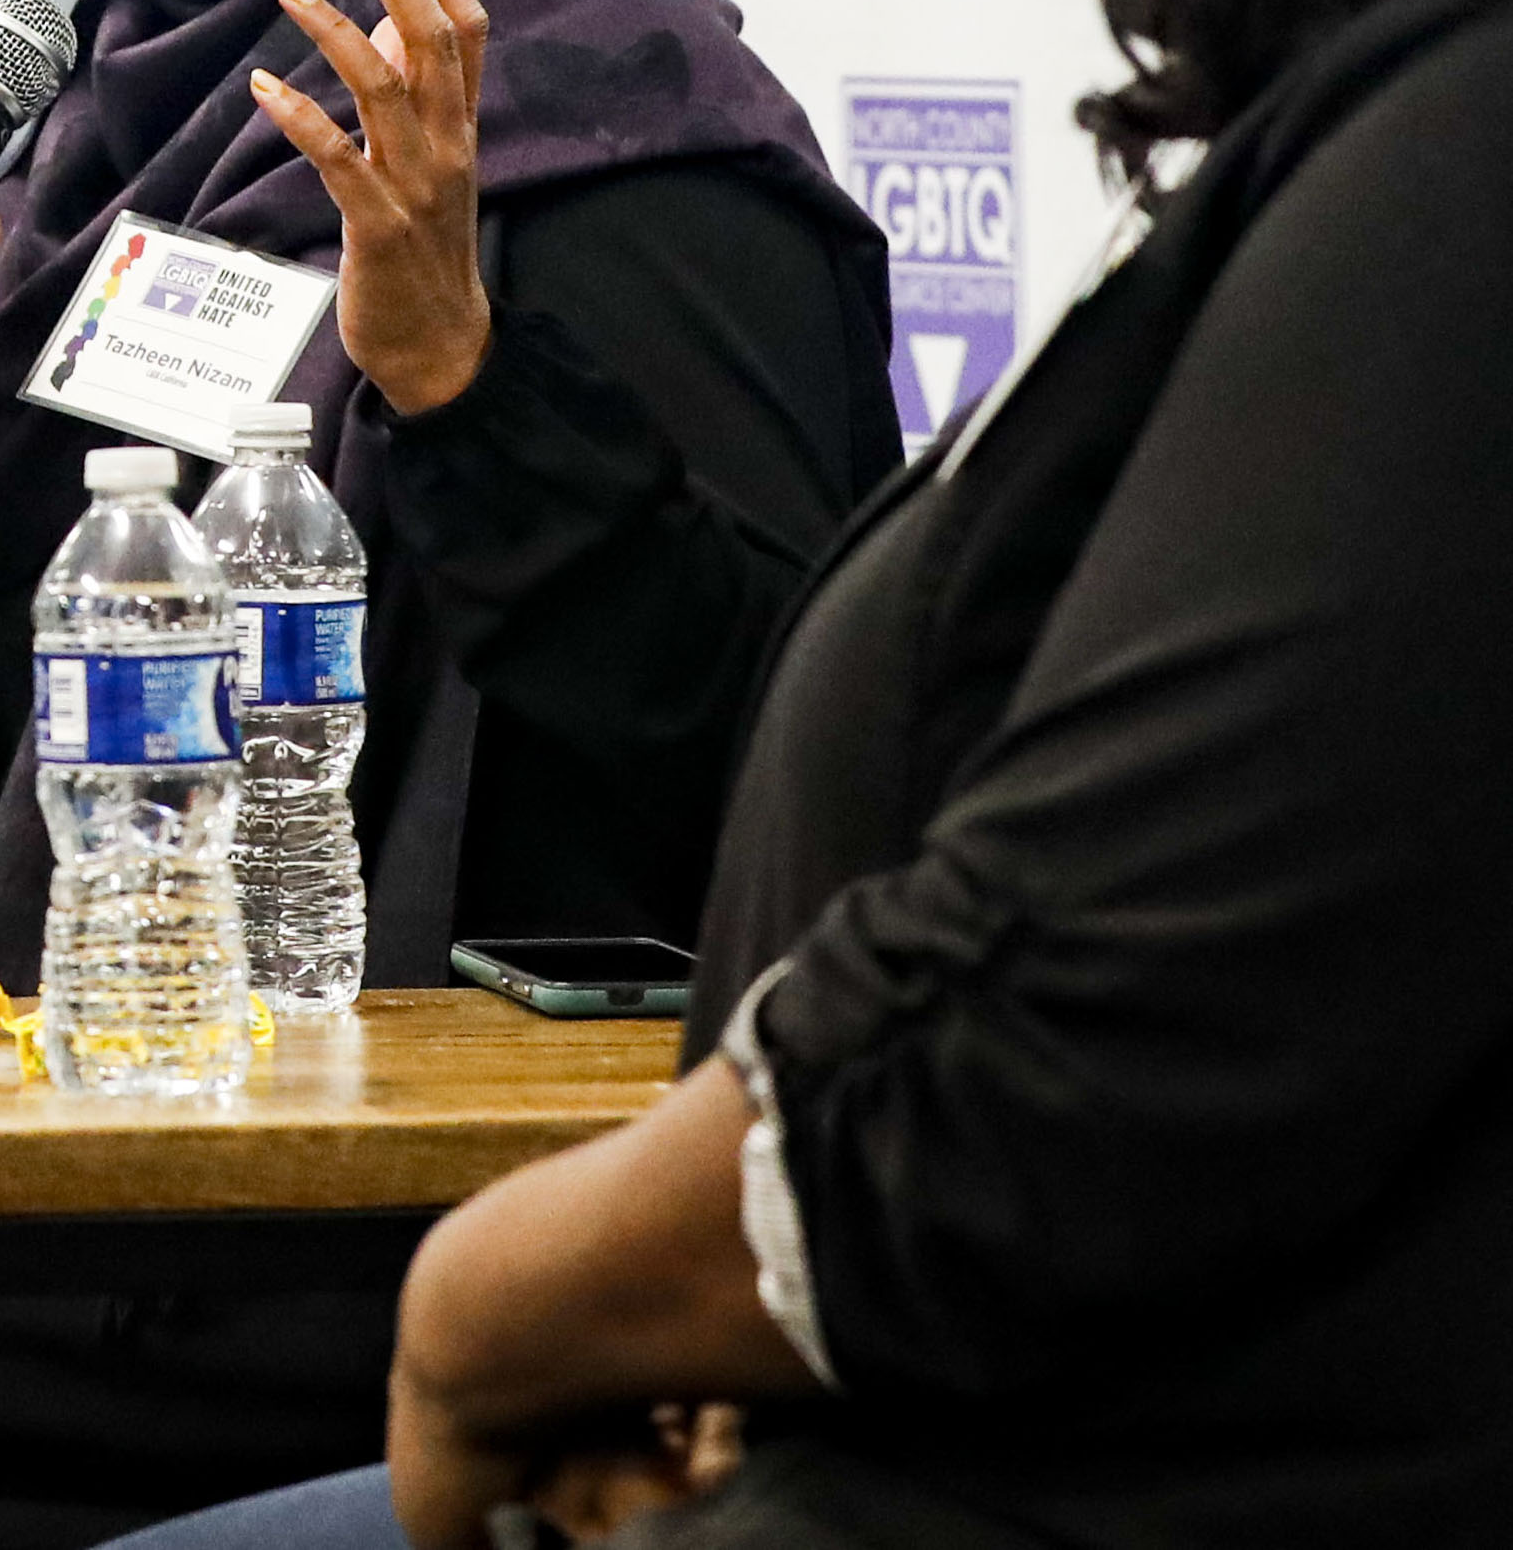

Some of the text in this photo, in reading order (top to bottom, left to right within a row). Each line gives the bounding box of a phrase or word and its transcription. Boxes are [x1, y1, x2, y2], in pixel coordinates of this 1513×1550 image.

[217, 269, 272, 298] UNITED
[197, 304, 236, 328] HATE
[206, 287, 274, 319] AGAINST
[104, 334, 183, 371] Tazheen
[187, 359, 253, 394] Nizam
